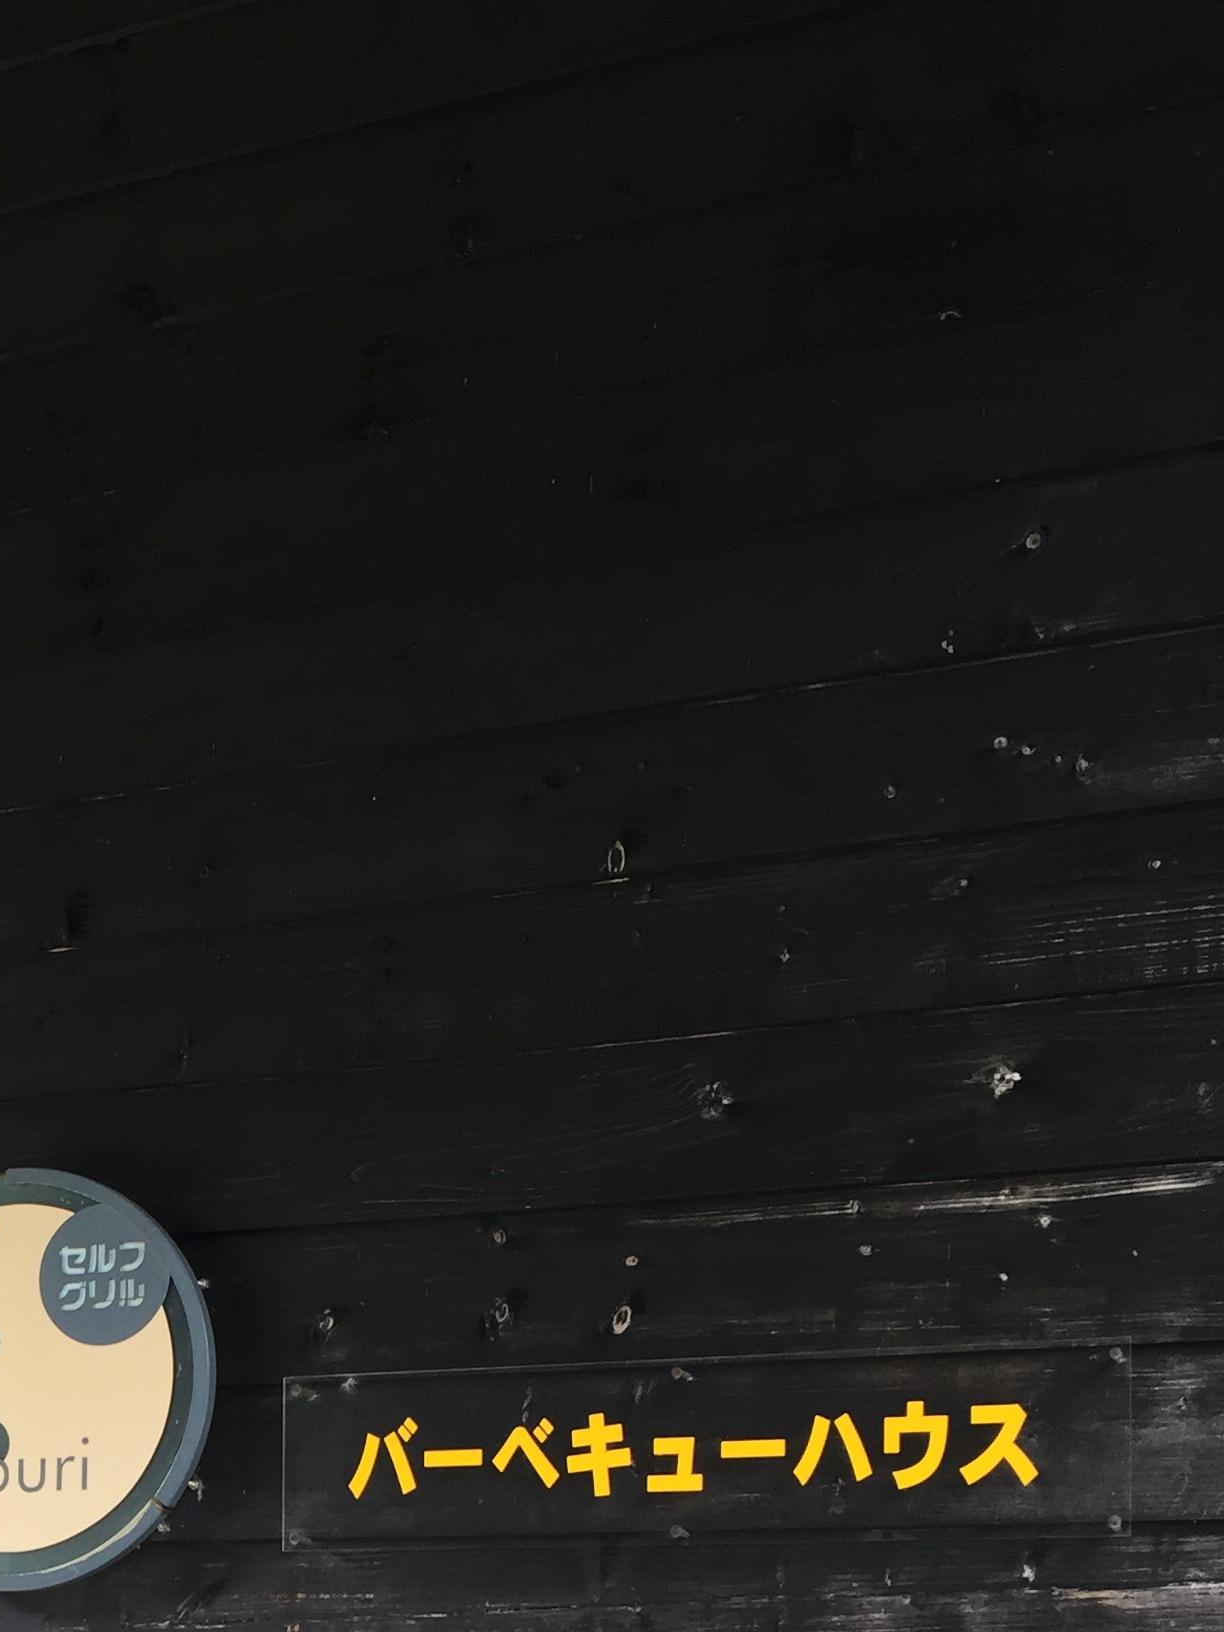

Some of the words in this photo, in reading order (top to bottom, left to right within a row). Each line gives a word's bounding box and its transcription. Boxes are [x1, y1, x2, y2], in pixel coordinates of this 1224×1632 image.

[57, 1240, 146, 1276] セルフ
[57, 1278, 146, 1312] グリル
[348, 1399, 1040, 1501] バーベキューハウス
